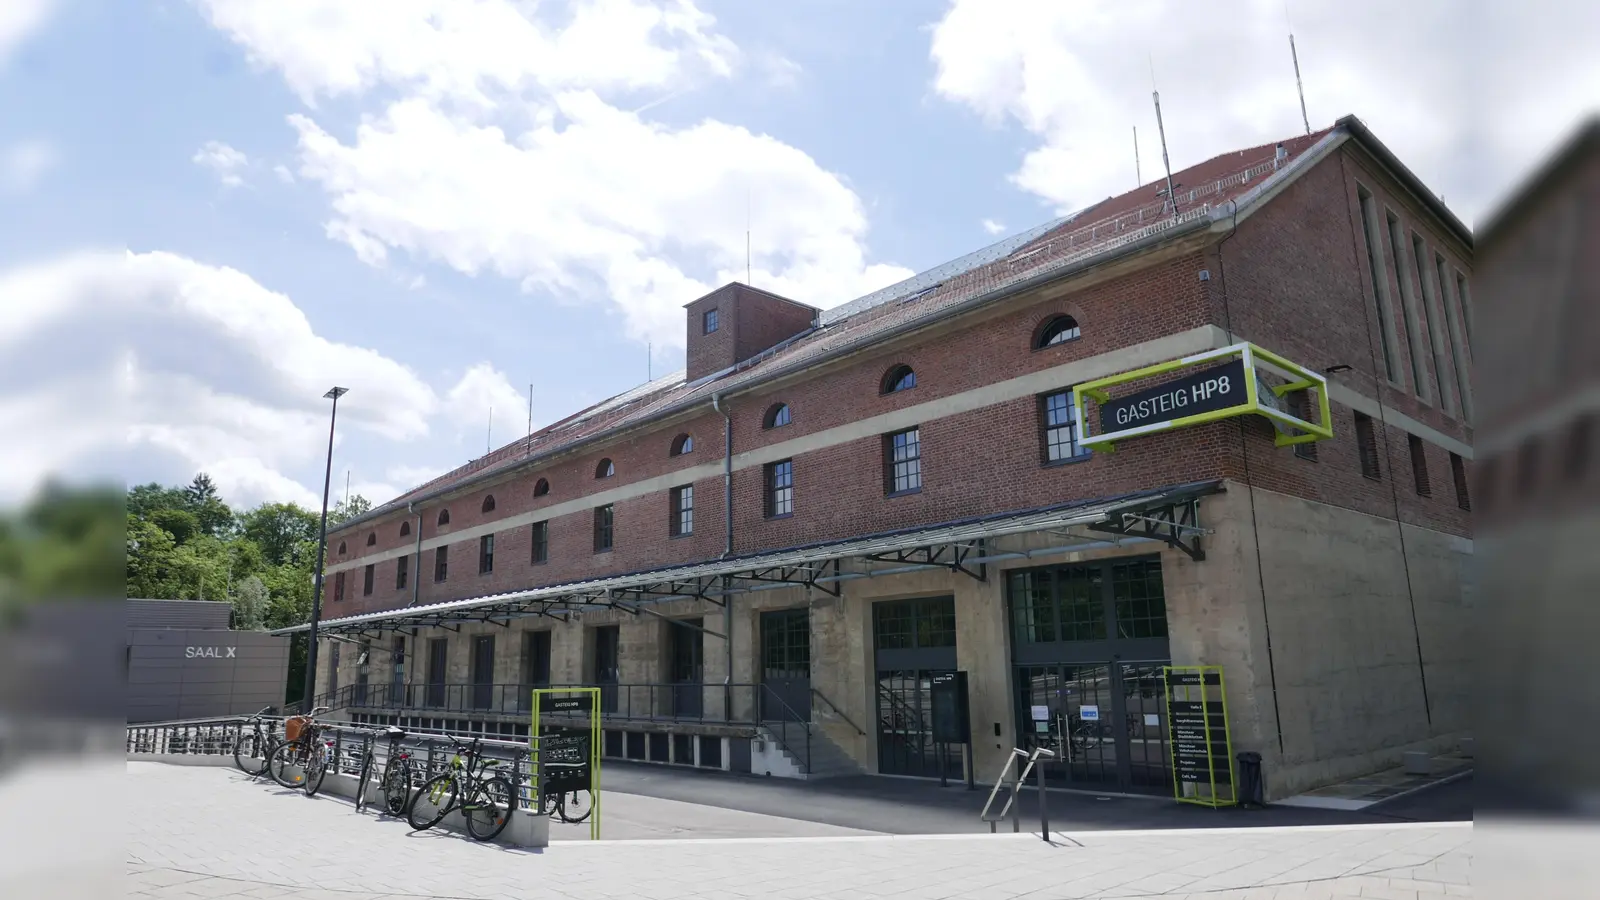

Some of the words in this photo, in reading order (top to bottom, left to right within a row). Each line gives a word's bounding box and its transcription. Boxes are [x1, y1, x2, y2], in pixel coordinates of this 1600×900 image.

[1116, 389, 1188, 424] GASTEIG
[1191, 375, 1231, 402] HP8
[185, 646, 222, 658] SAAL
[226, 646, 236, 658] X
